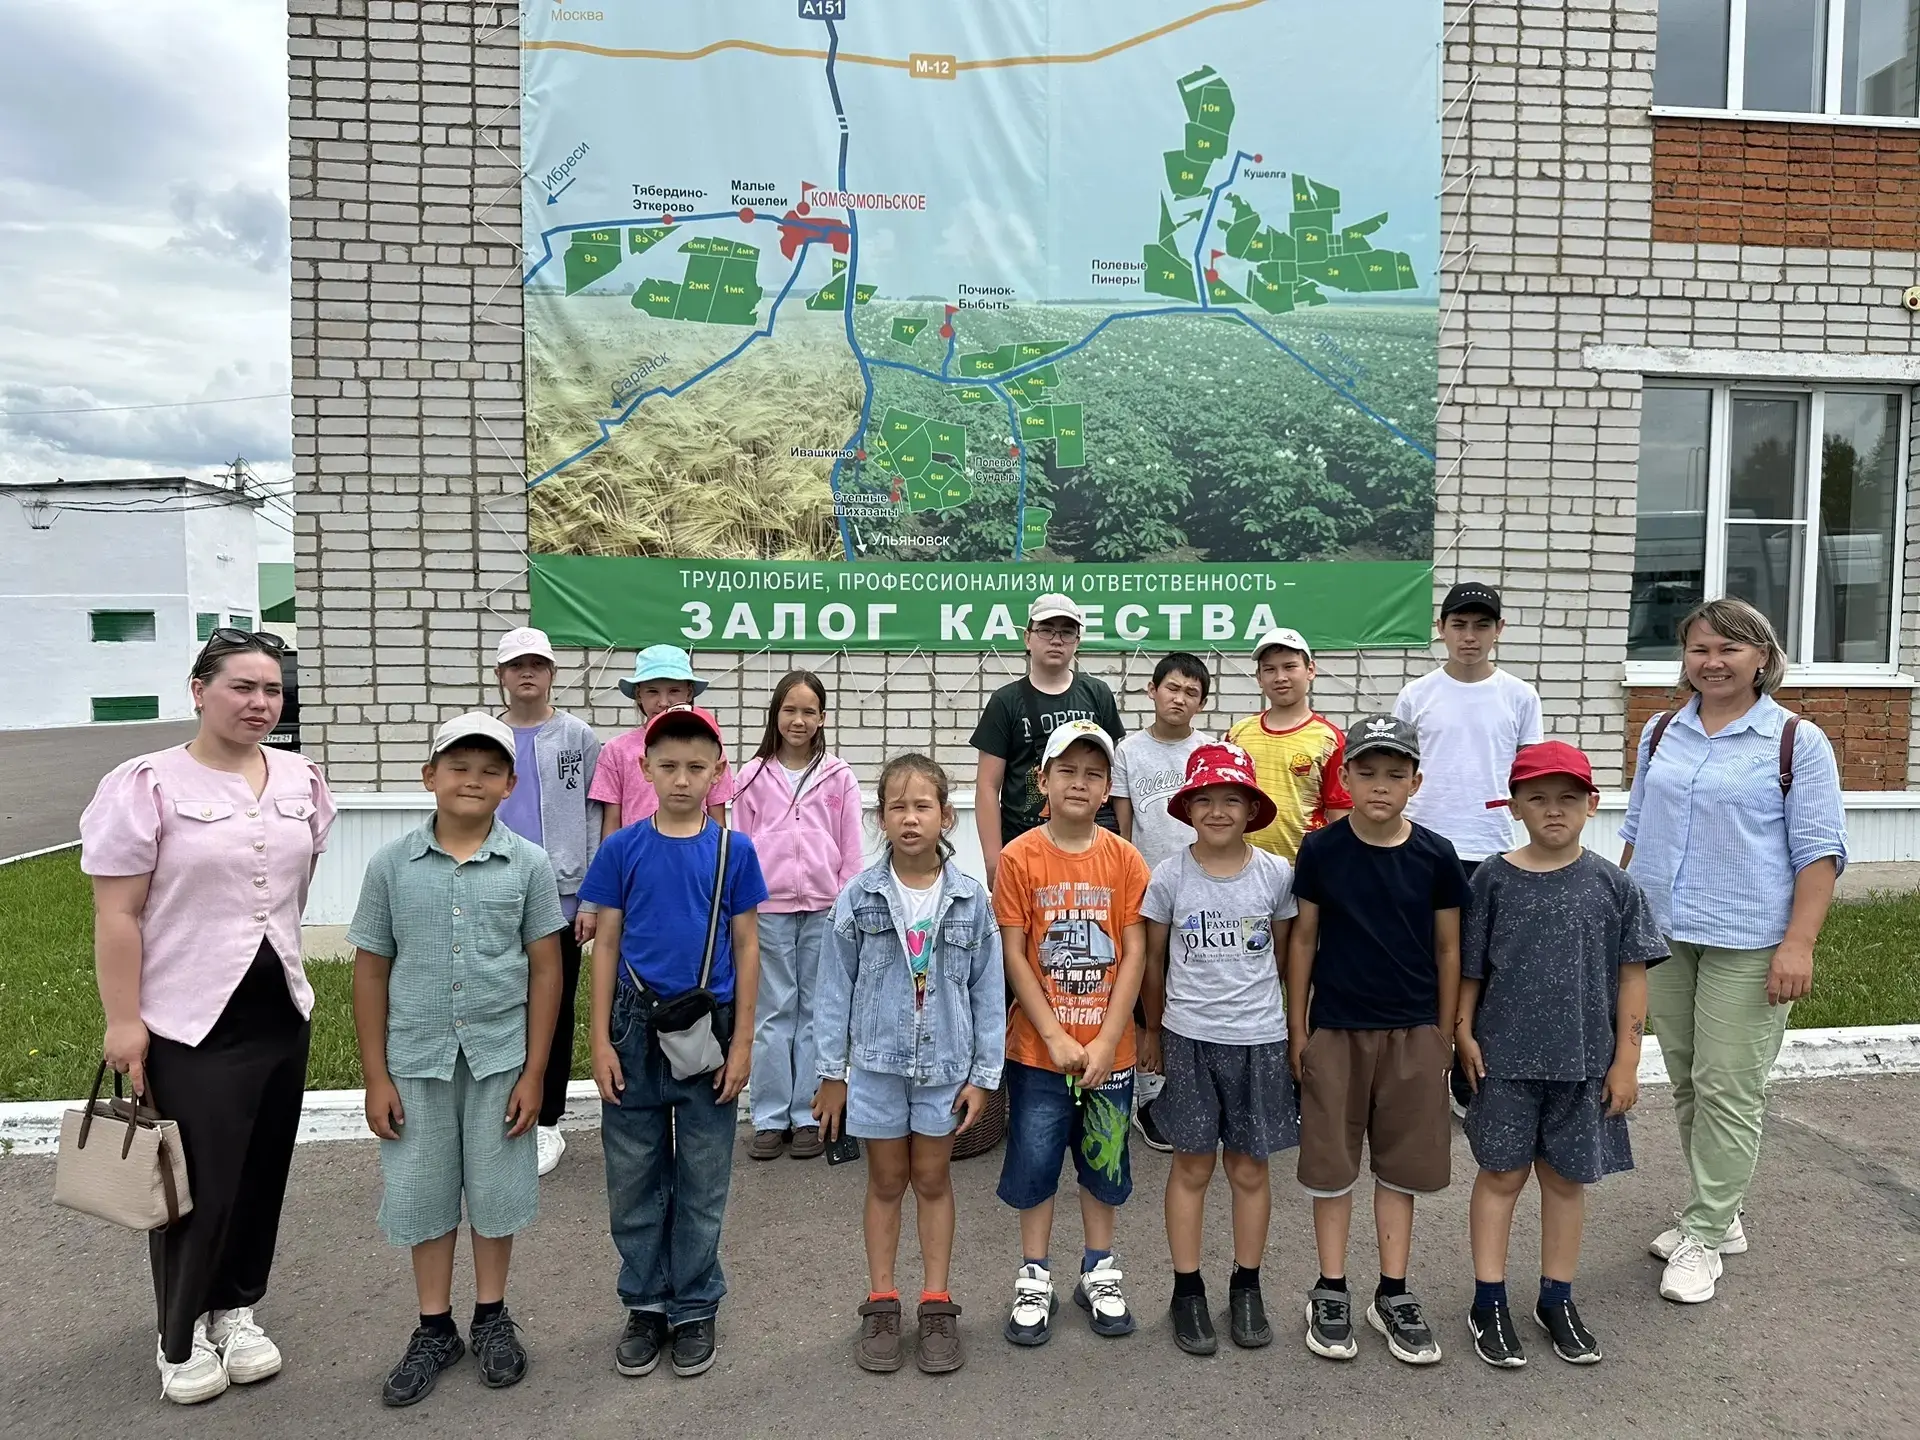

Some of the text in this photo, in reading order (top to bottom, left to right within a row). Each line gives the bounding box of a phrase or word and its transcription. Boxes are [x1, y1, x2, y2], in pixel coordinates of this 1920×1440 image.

[551, 9, 604, 21] Москва
[916, 60, 949, 74] М-12
[1202, 103, 1220, 112] 10я
[1197, 139, 1210, 148] 9я
[541, 141, 590, 191] Ибреси
[1181, 171, 1194, 180] 8я
[1243, 168, 1287, 180] Кушелга
[731, 180, 775, 191] Малые
[632, 184, 708, 199] Тябердино-
[731, 195, 788, 206] Кошелеи
[811, 191, 926, 210] КОМСОМОЛЬСКОЕ
[632, 199, 694, 213] Эткерово
[591, 233, 609, 241] 10э
[635, 235, 648, 244] 8э
[1306, 233, 1318, 242] 2я
[688, 242, 706, 250] 6мк
[712, 244, 729, 252] 5мк
[736, 247, 755, 255] 4мк
[584, 254, 598, 263] 9э
[834, 261, 845, 269] 4к
[1091, 259, 1148, 270] Полевые
[1162, 271, 1176, 280] 7я
[1327, 268, 1339, 276] 3я
[1091, 274, 1140, 286] Пинеры
[688, 281, 710, 290] 2мк
[723, 285, 745, 294] 1мк
[958, 284, 1015, 296] Починок-
[822, 291, 836, 300] 6к
[856, 291, 871, 300] 5к
[1214, 288, 1227, 296] 6я
[648, 293, 671, 303] 3мк
[958, 298, 1010, 310] Быбыть
[611, 352, 671, 395] Саранск
[894, 422, 908, 430] 2ш
[790, 447, 854, 458] Ивашкино
[901, 454, 915, 462] 4ш
[833, 492, 888, 503] Степные
[913, 491, 926, 499] 7ш
[833, 506, 898, 517] Шихазаны
[679, 570, 830, 593] ТРУДОЛЮБИЕ,
[839, 572, 1054, 592] ПРОФЕССИОНАЛИЗМ
[1062, 574, 1074, 592] И
[1081, 573, 1277, 592] ОТВЕТСТВЕННОСТЬ
[680, 601, 1279, 641] ЗАЛОГ КАЕСТВА
[1207, 911, 1223, 919] MY
[1207, 920, 1240, 930] FAXED
